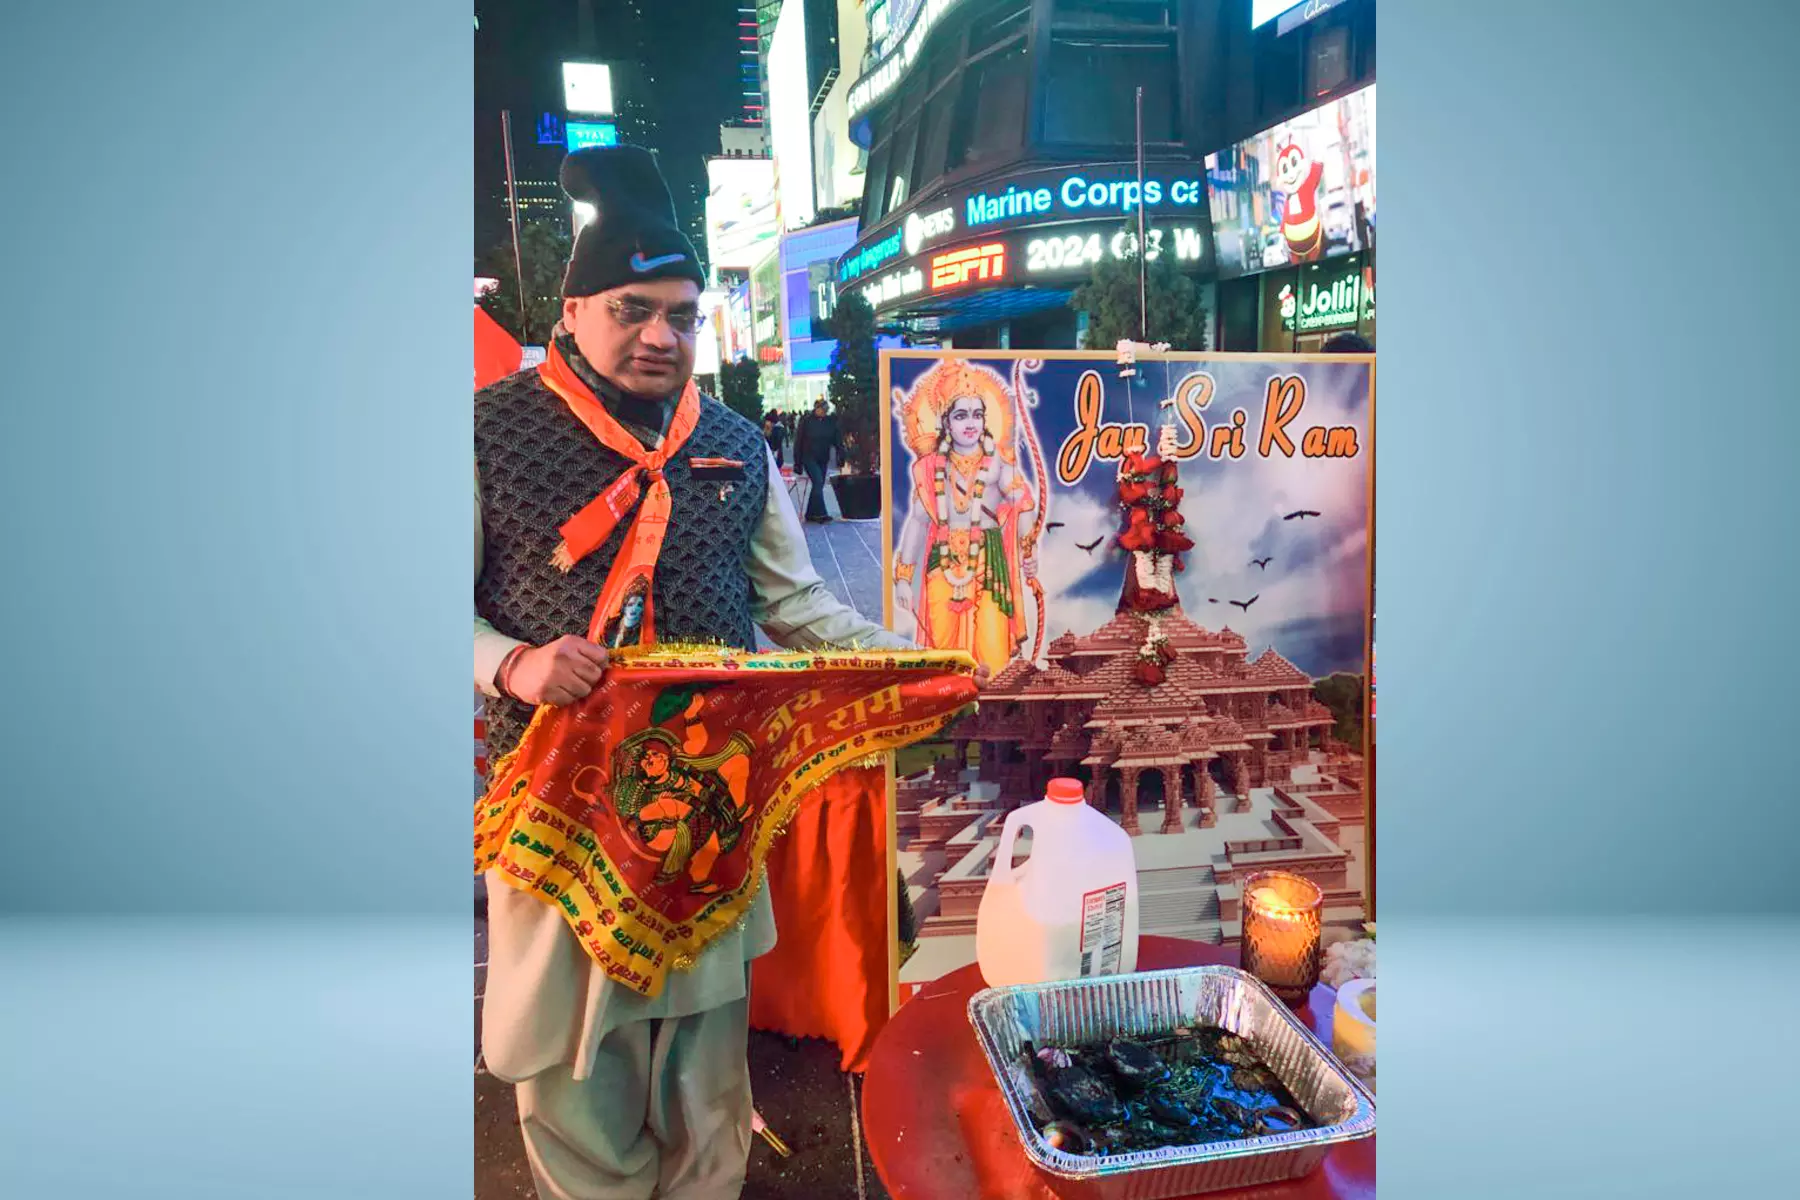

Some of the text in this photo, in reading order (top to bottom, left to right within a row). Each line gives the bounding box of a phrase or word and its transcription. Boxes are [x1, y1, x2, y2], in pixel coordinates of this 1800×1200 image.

[967, 186, 1051, 226] Marine
[1061, 177, 1162, 212] Corps
[931, 244, 1005, 289] ESPN
[1026, 232, 1102, 272] 2024
[1163, 372, 1247, 459] Sri
[1258, 374, 1360, 459] Ram
[758, 688, 827, 744] जय
[825, 683, 904, 731] राम
